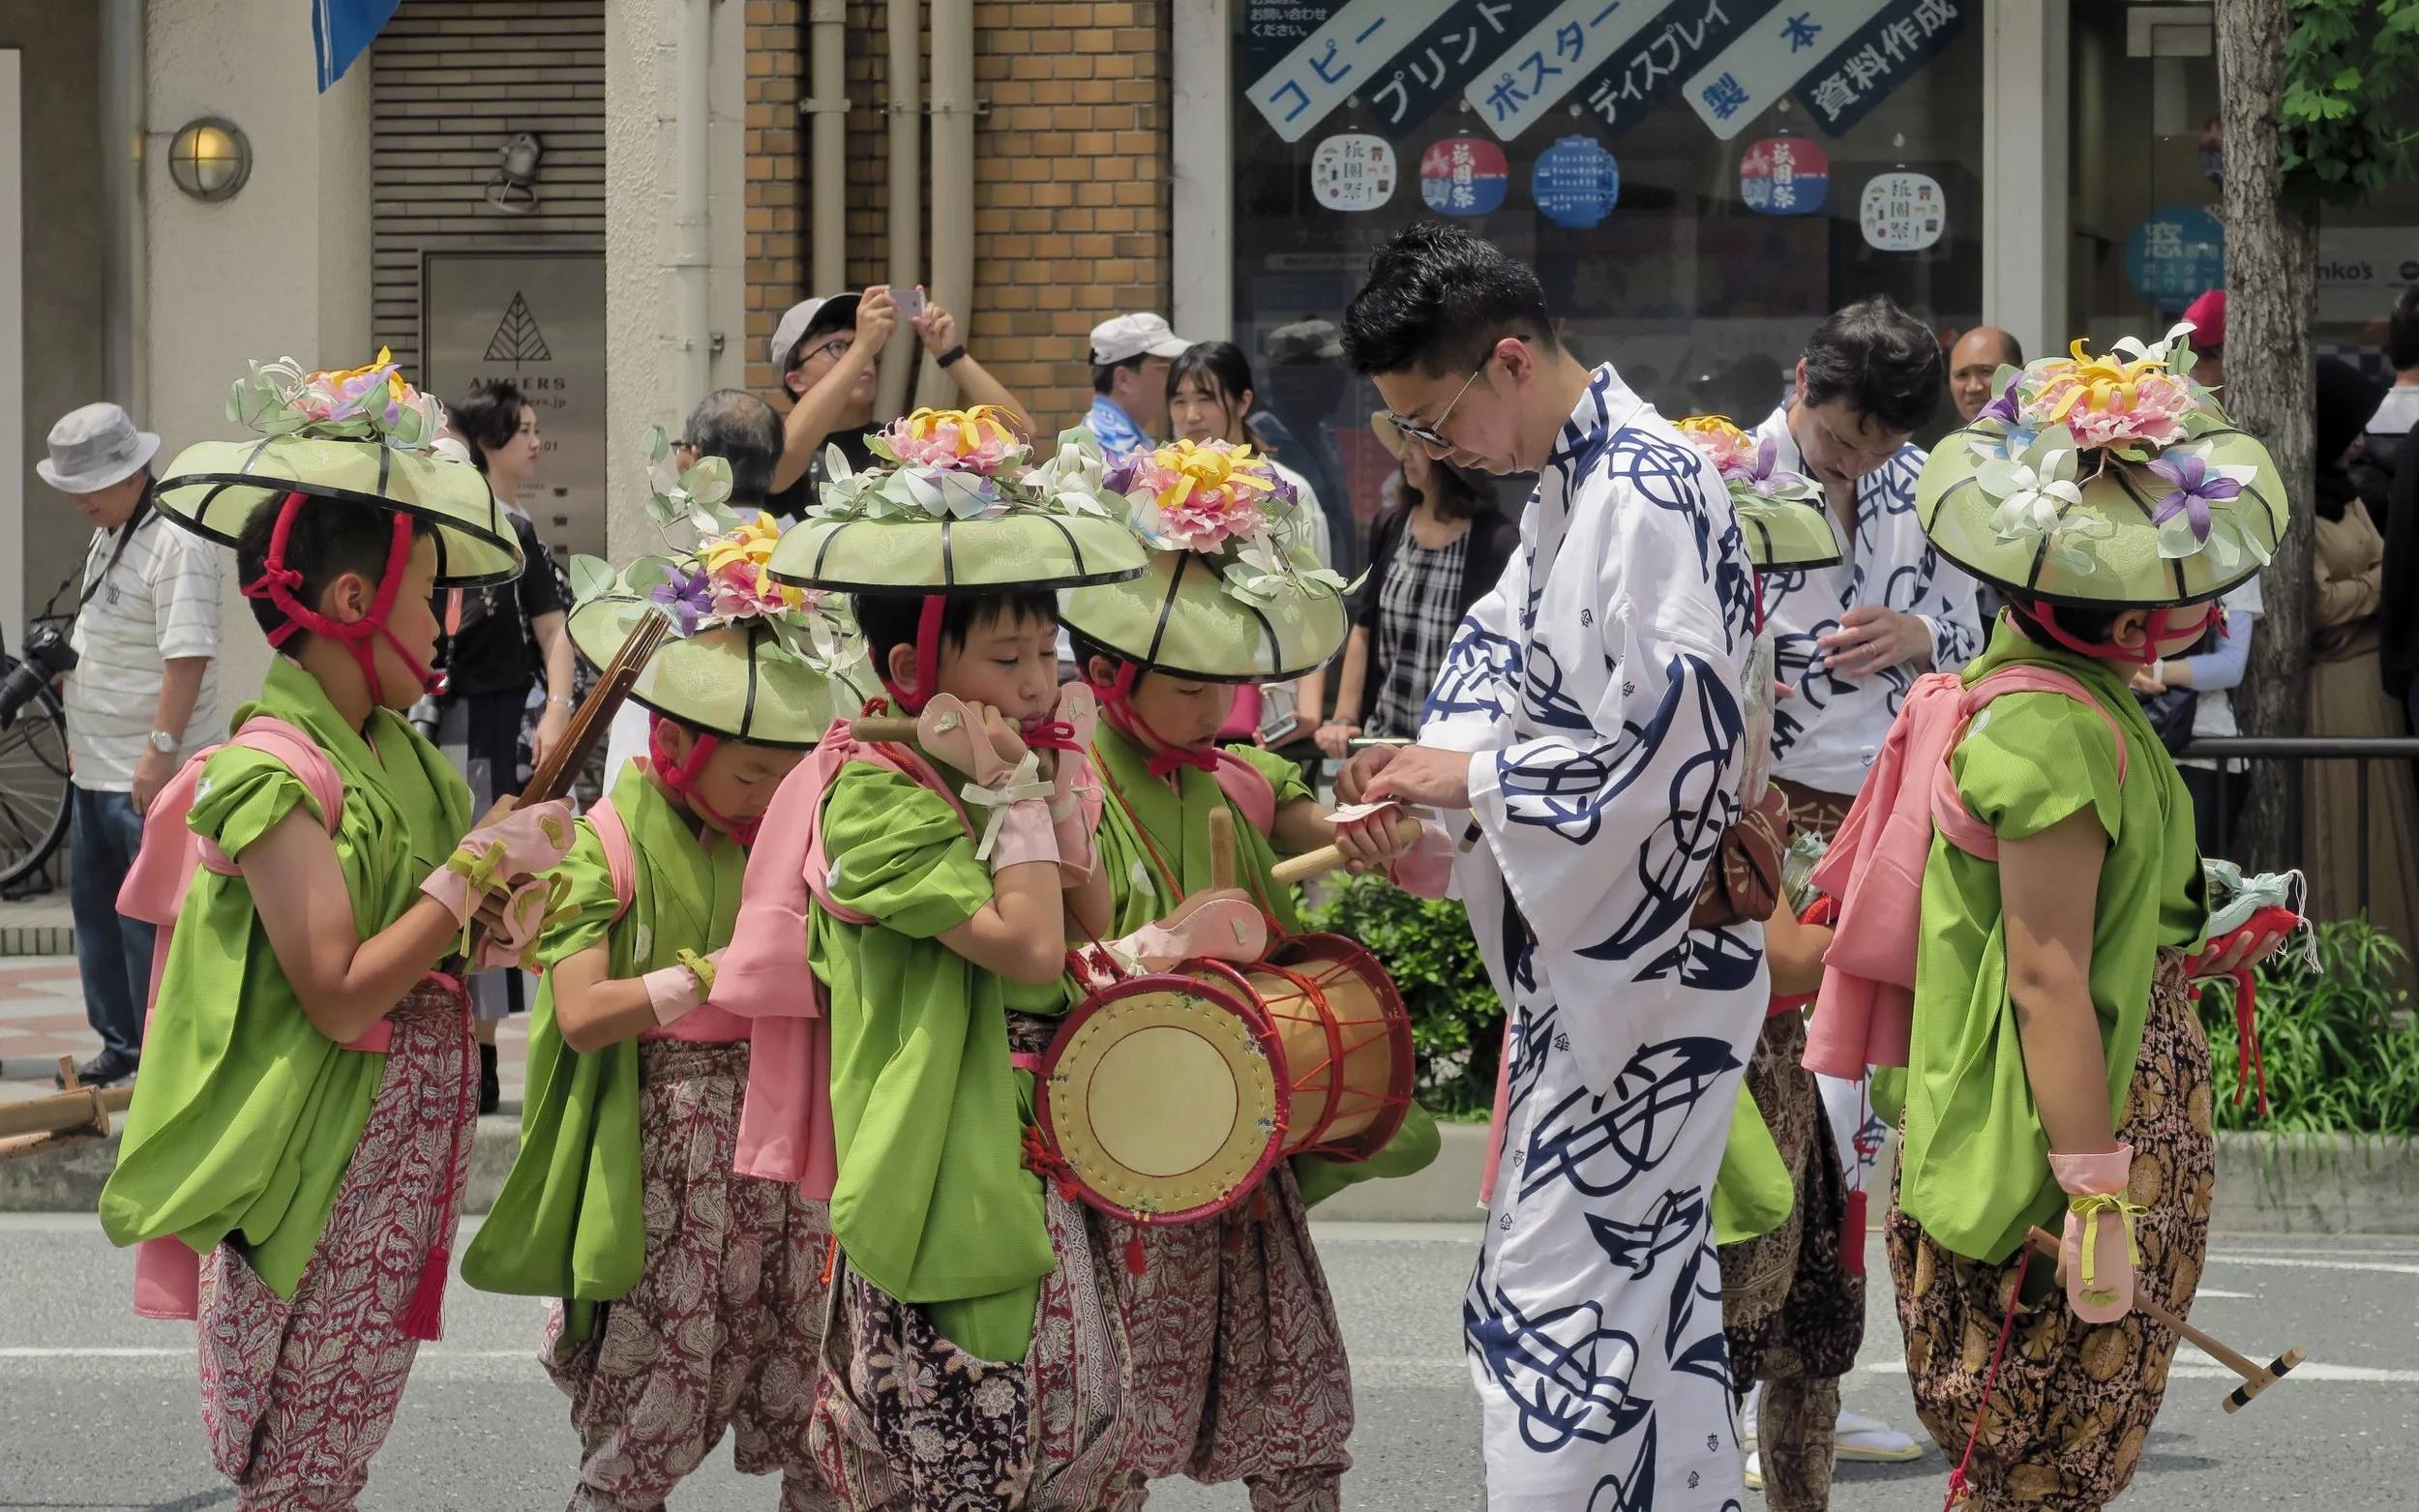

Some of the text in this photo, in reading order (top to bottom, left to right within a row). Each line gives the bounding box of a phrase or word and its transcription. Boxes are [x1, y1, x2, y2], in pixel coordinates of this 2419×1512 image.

[1250, 8, 1328, 21] お問い合わせ
[1251, 24, 1308, 37] ください。
[1269, 16, 1386, 123] コピー
[1372, 1, 1512, 124] プリント
[1485, 1, 1621, 121] ポスター
[1588, 0, 1730, 125] ディスプレイ
[1810, 0, 1958, 122] 資料作成
[2316, 260, 2374, 281] nko's
